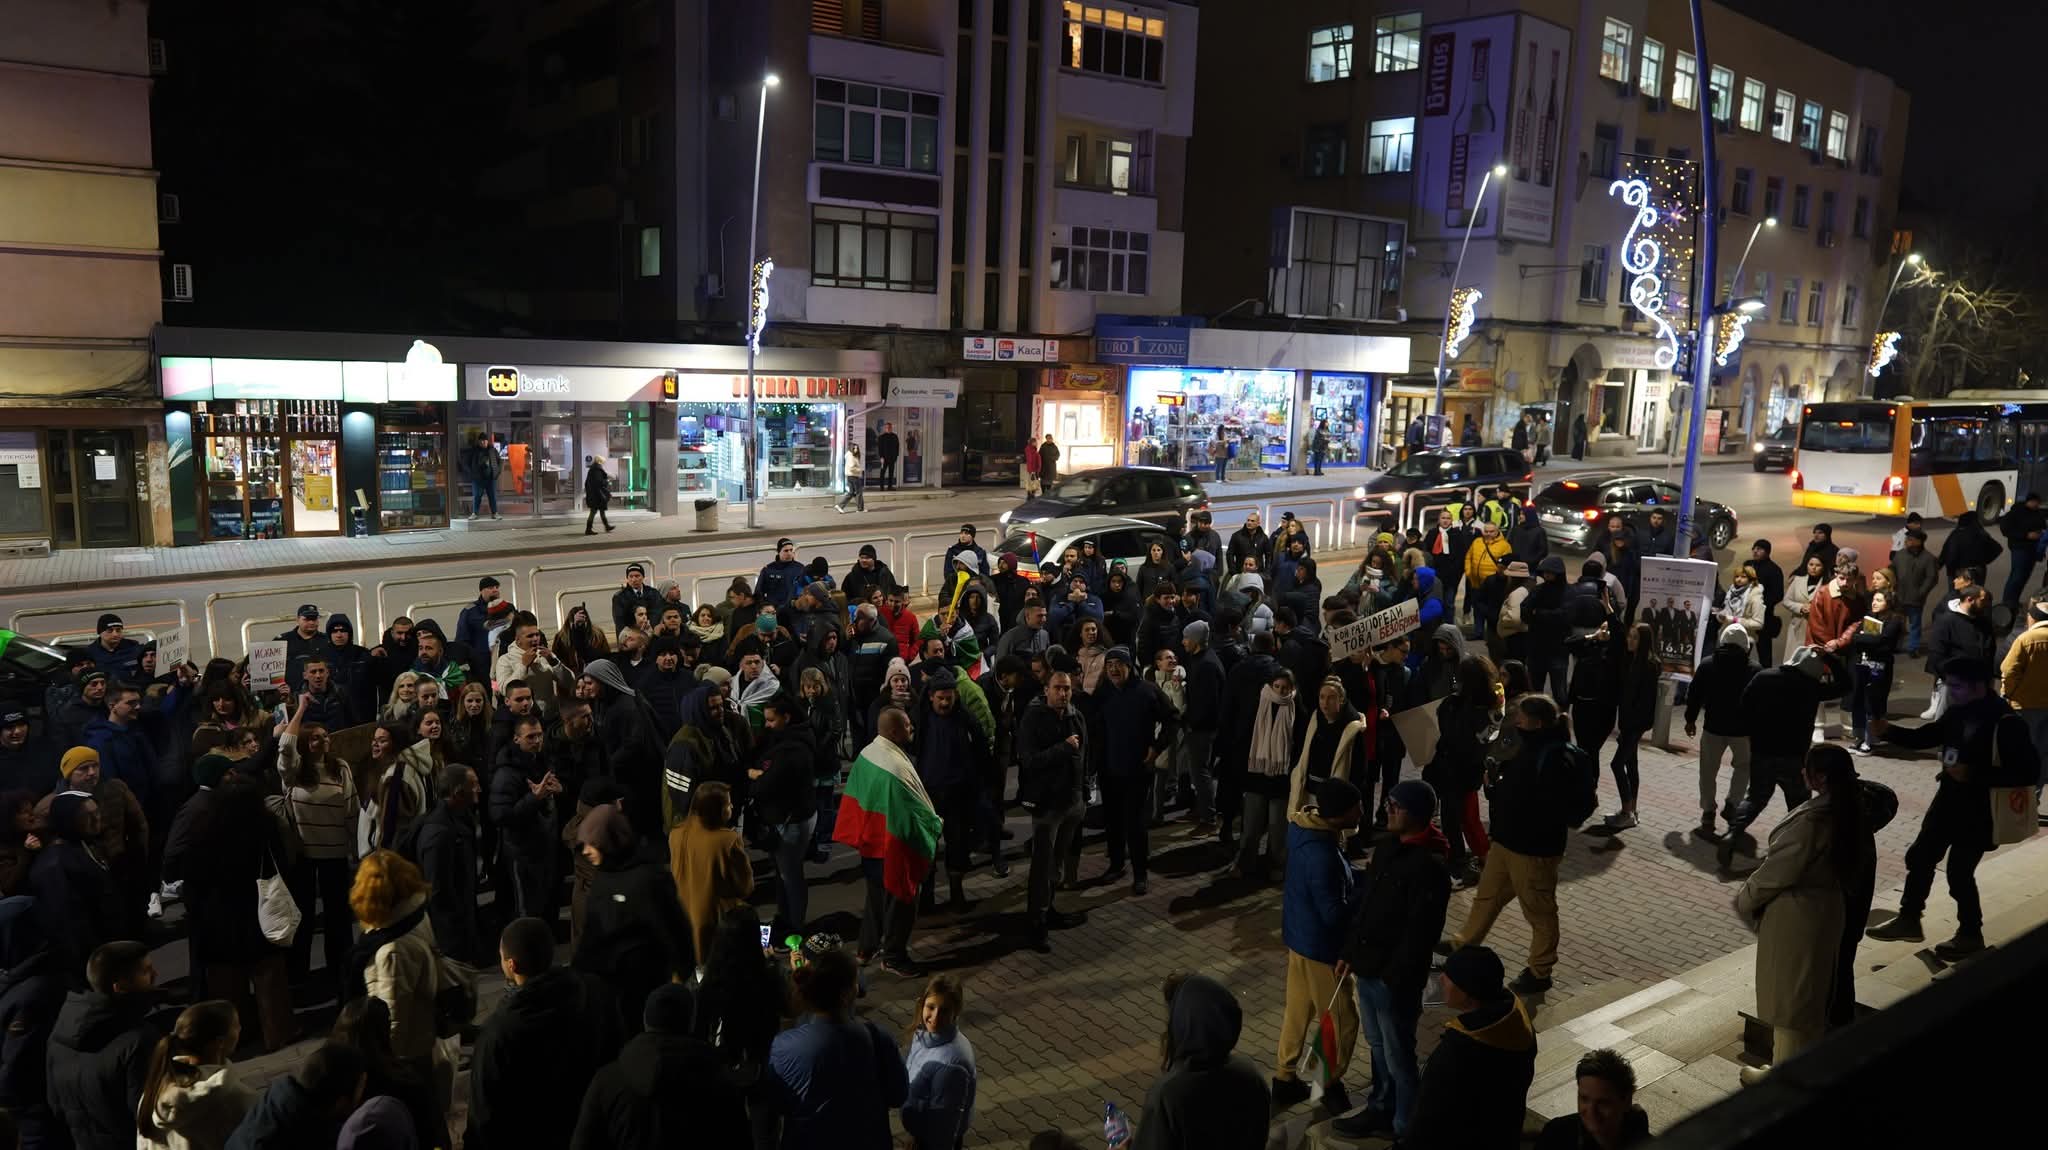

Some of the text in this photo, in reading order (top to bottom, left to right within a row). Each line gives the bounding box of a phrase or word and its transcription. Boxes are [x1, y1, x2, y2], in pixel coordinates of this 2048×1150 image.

[1149, 343, 1185, 355] ZONE
[489, 374, 570, 393] tbi bank
[1334, 605, 1403, 643] КОЙ РАЗПОРЕДИ
[1343, 631, 1372, 653] ТОВА
[1660, 640, 1694, 656] 16.12
[254, 646, 283, 660] ИСКАМЕ
